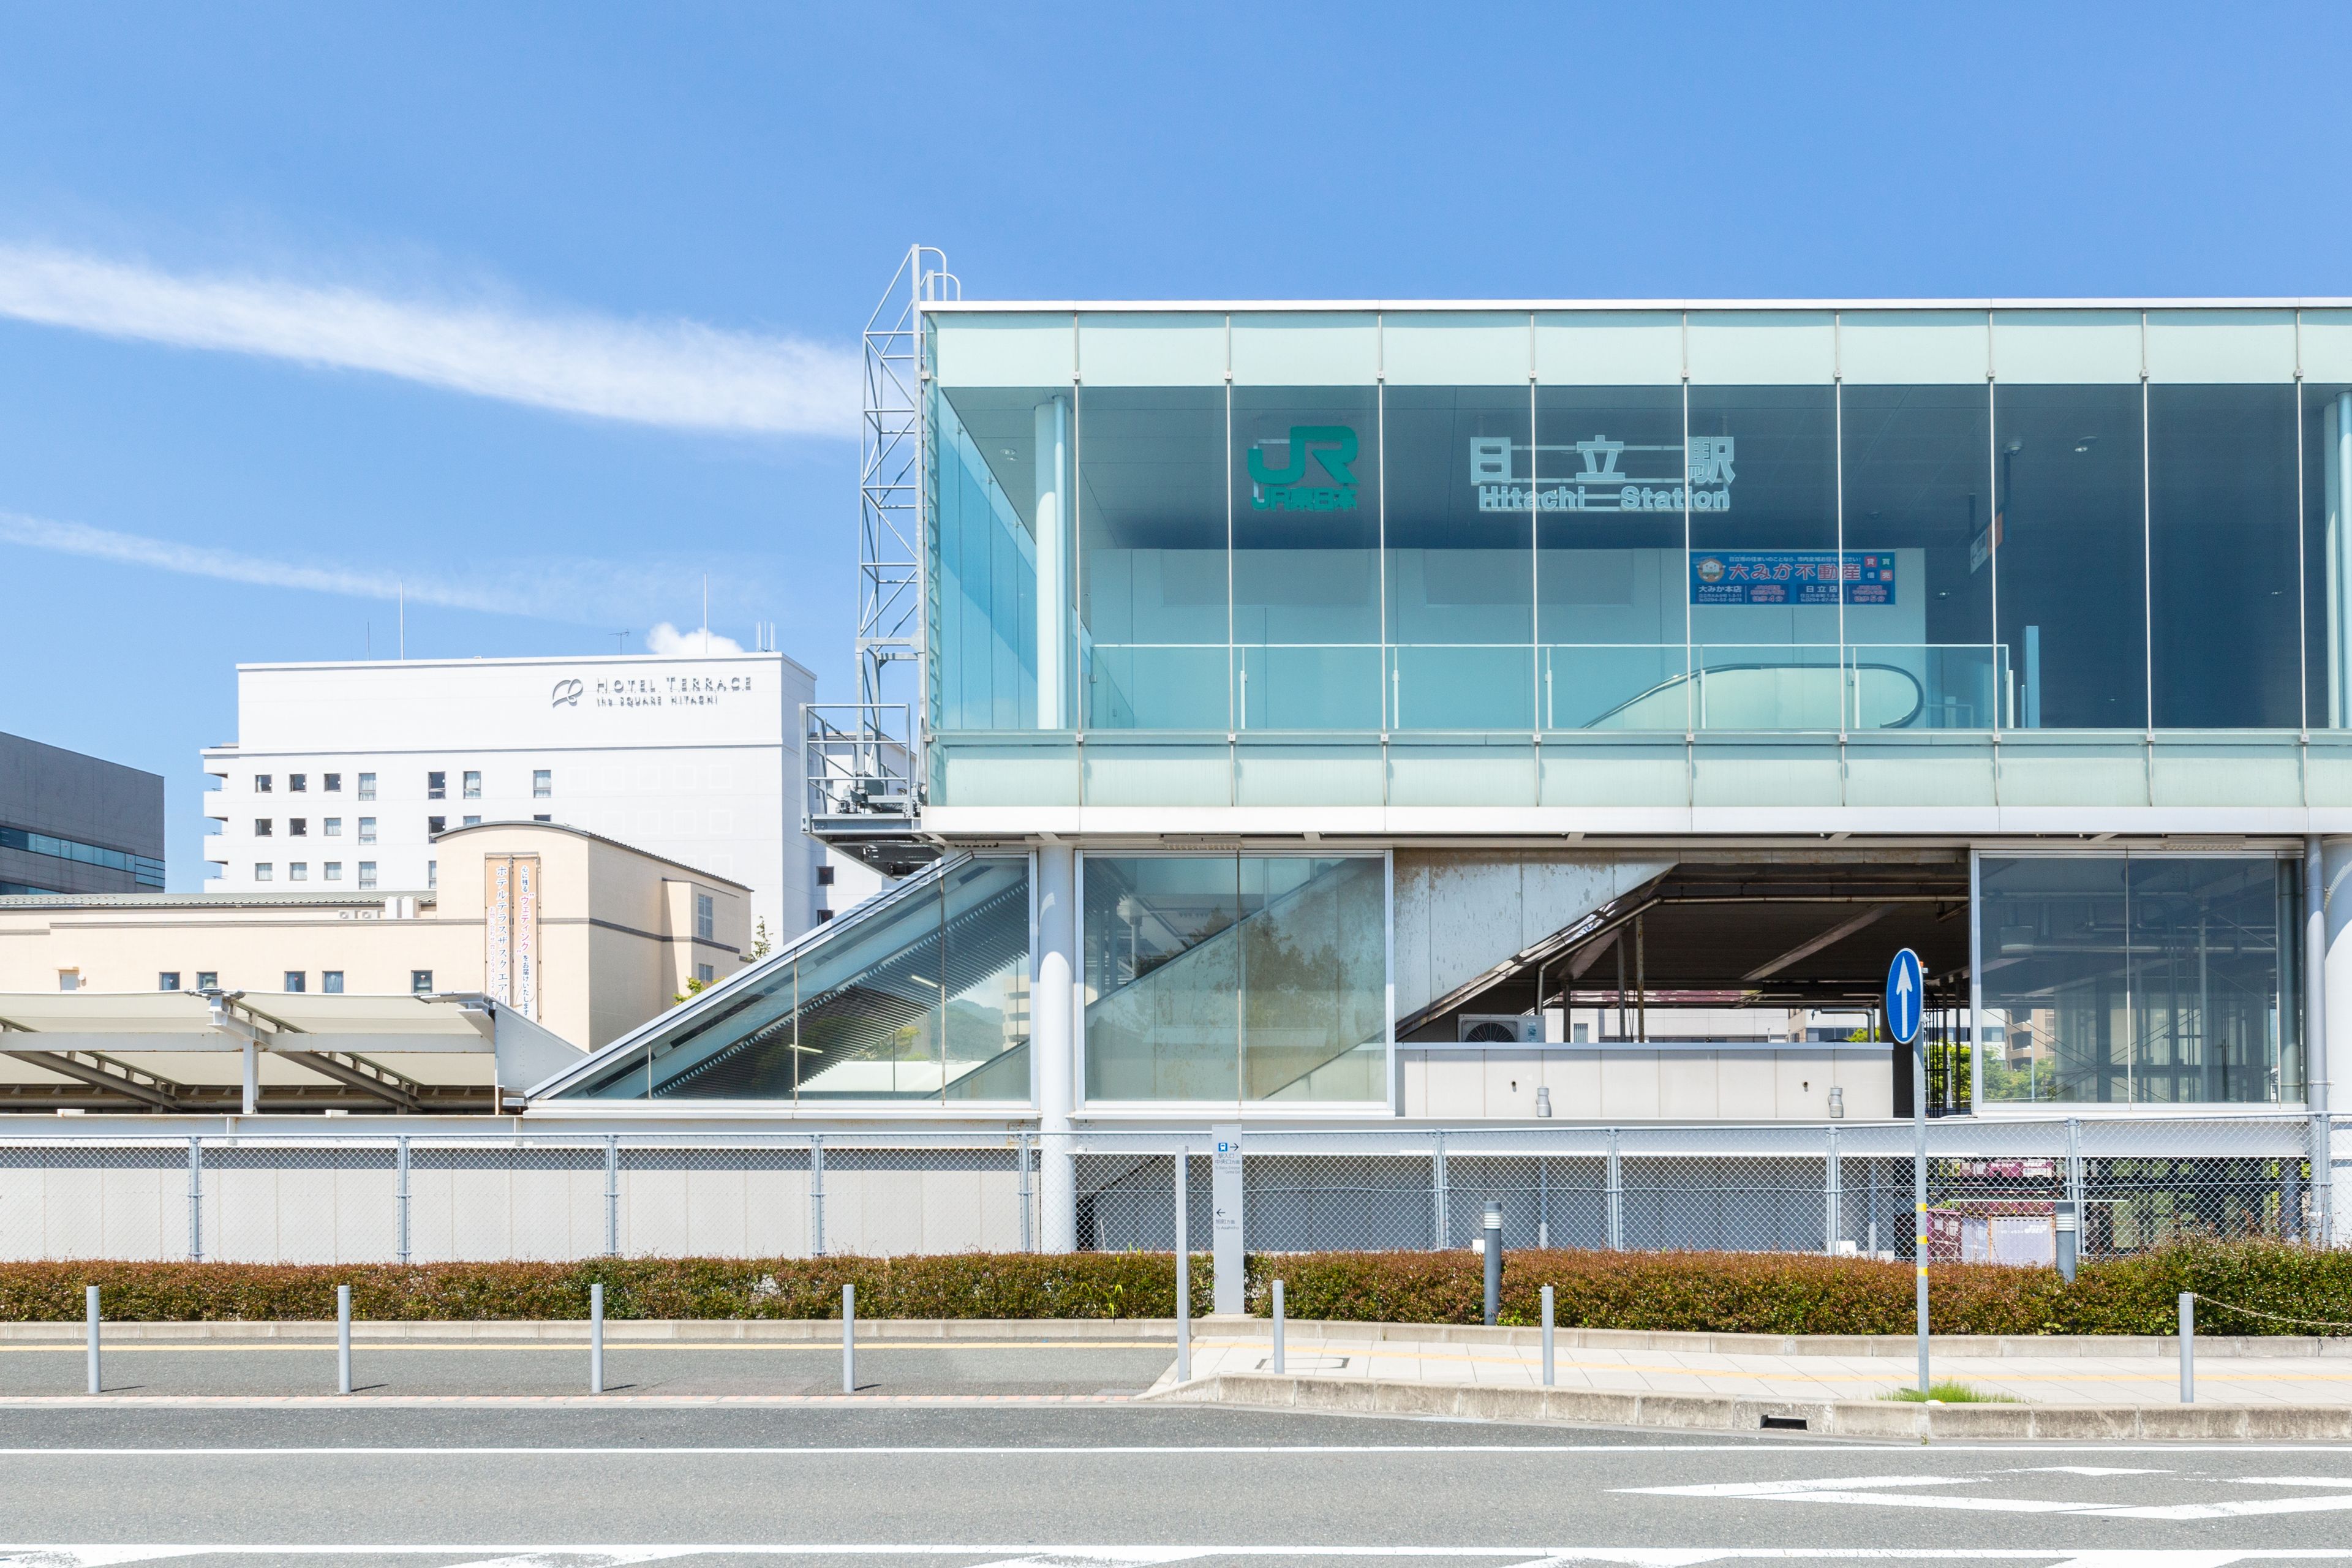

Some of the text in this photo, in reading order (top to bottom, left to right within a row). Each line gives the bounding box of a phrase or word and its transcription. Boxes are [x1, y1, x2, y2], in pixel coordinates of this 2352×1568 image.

[1248, 426, 1359, 486] JR
[1470, 435, 1736, 486] 日立駅
[1251, 486, 1358, 511] JR東日本
[1479, 486, 1730, 511] Hitachi Station
[1728, 563, 1861, 581] 大みか不動産
[597, 676, 752, 694] HOTEL TERRACE
